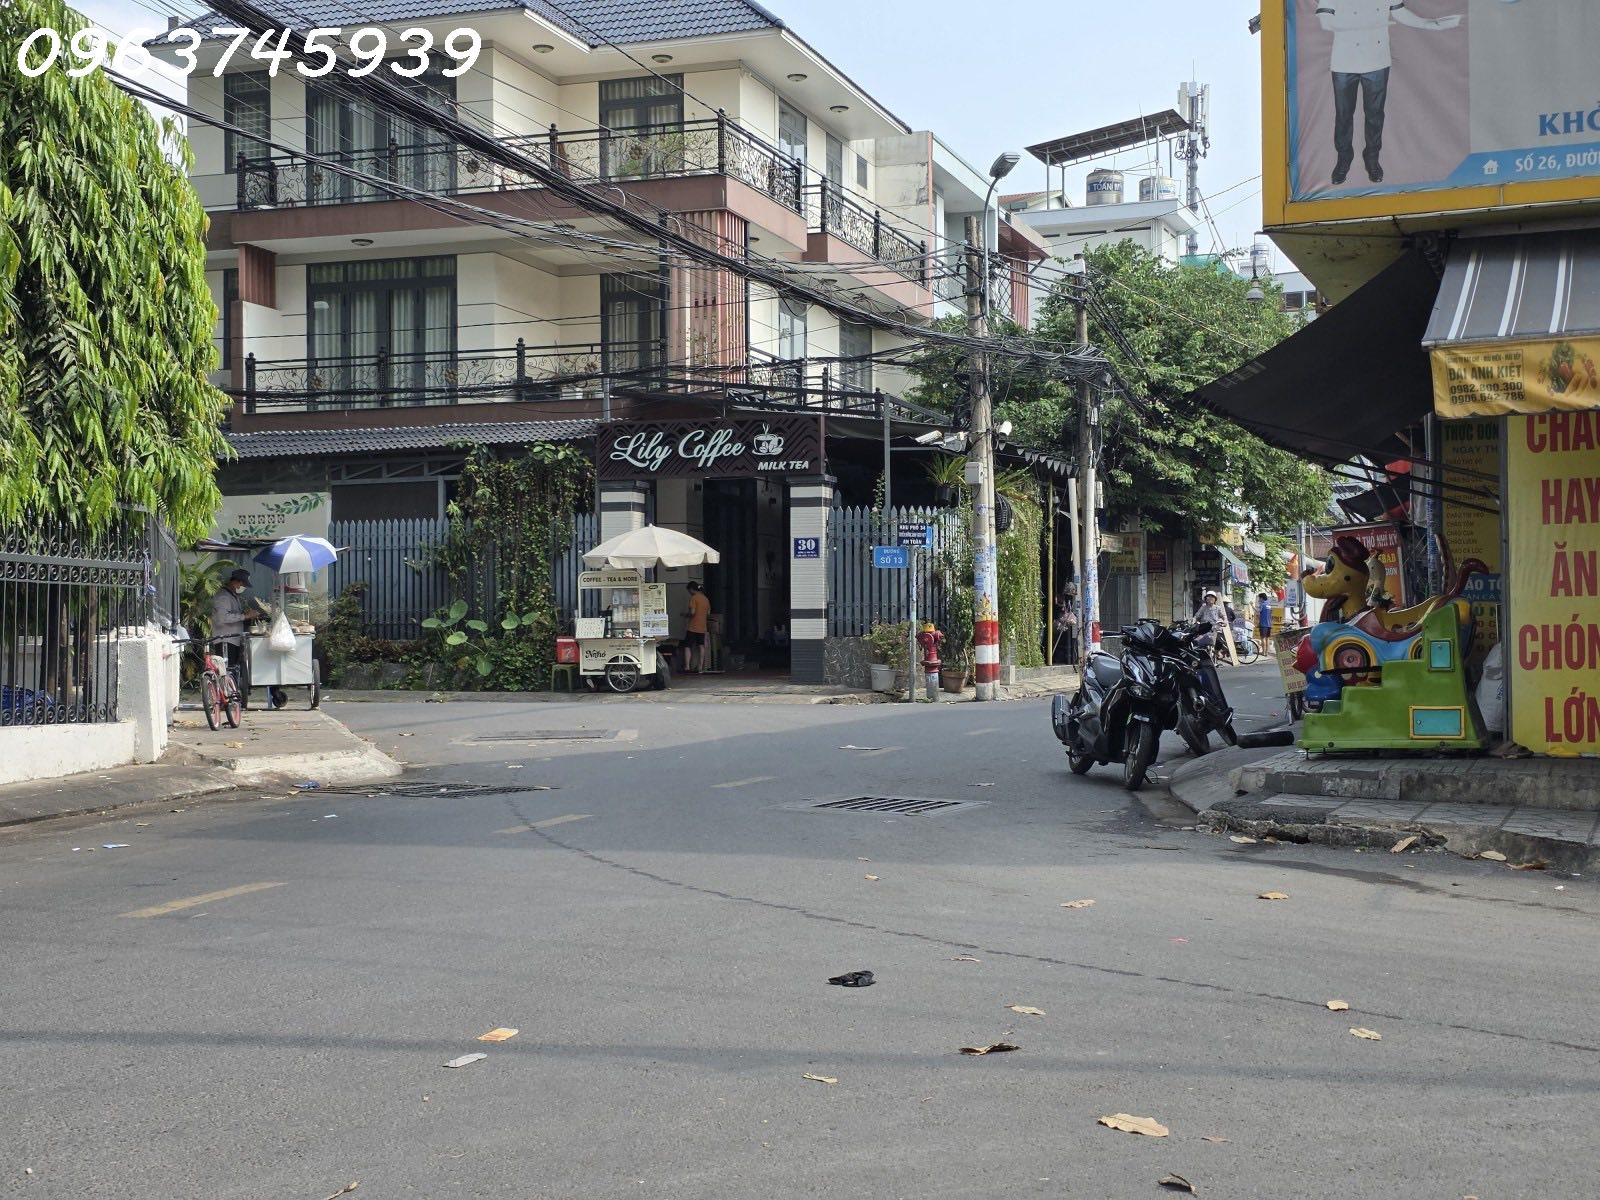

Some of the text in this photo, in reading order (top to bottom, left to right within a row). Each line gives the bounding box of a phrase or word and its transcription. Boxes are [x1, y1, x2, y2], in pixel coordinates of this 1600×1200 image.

[1515, 148, 1600, 172] SỐ 26, ĐƯỜ
[1471, 366, 1494, 380] ANH
[610, 428, 746, 471] Lily Coffee
[757, 460, 809, 470] MILK TEA
[798, 539, 816, 551] 30
